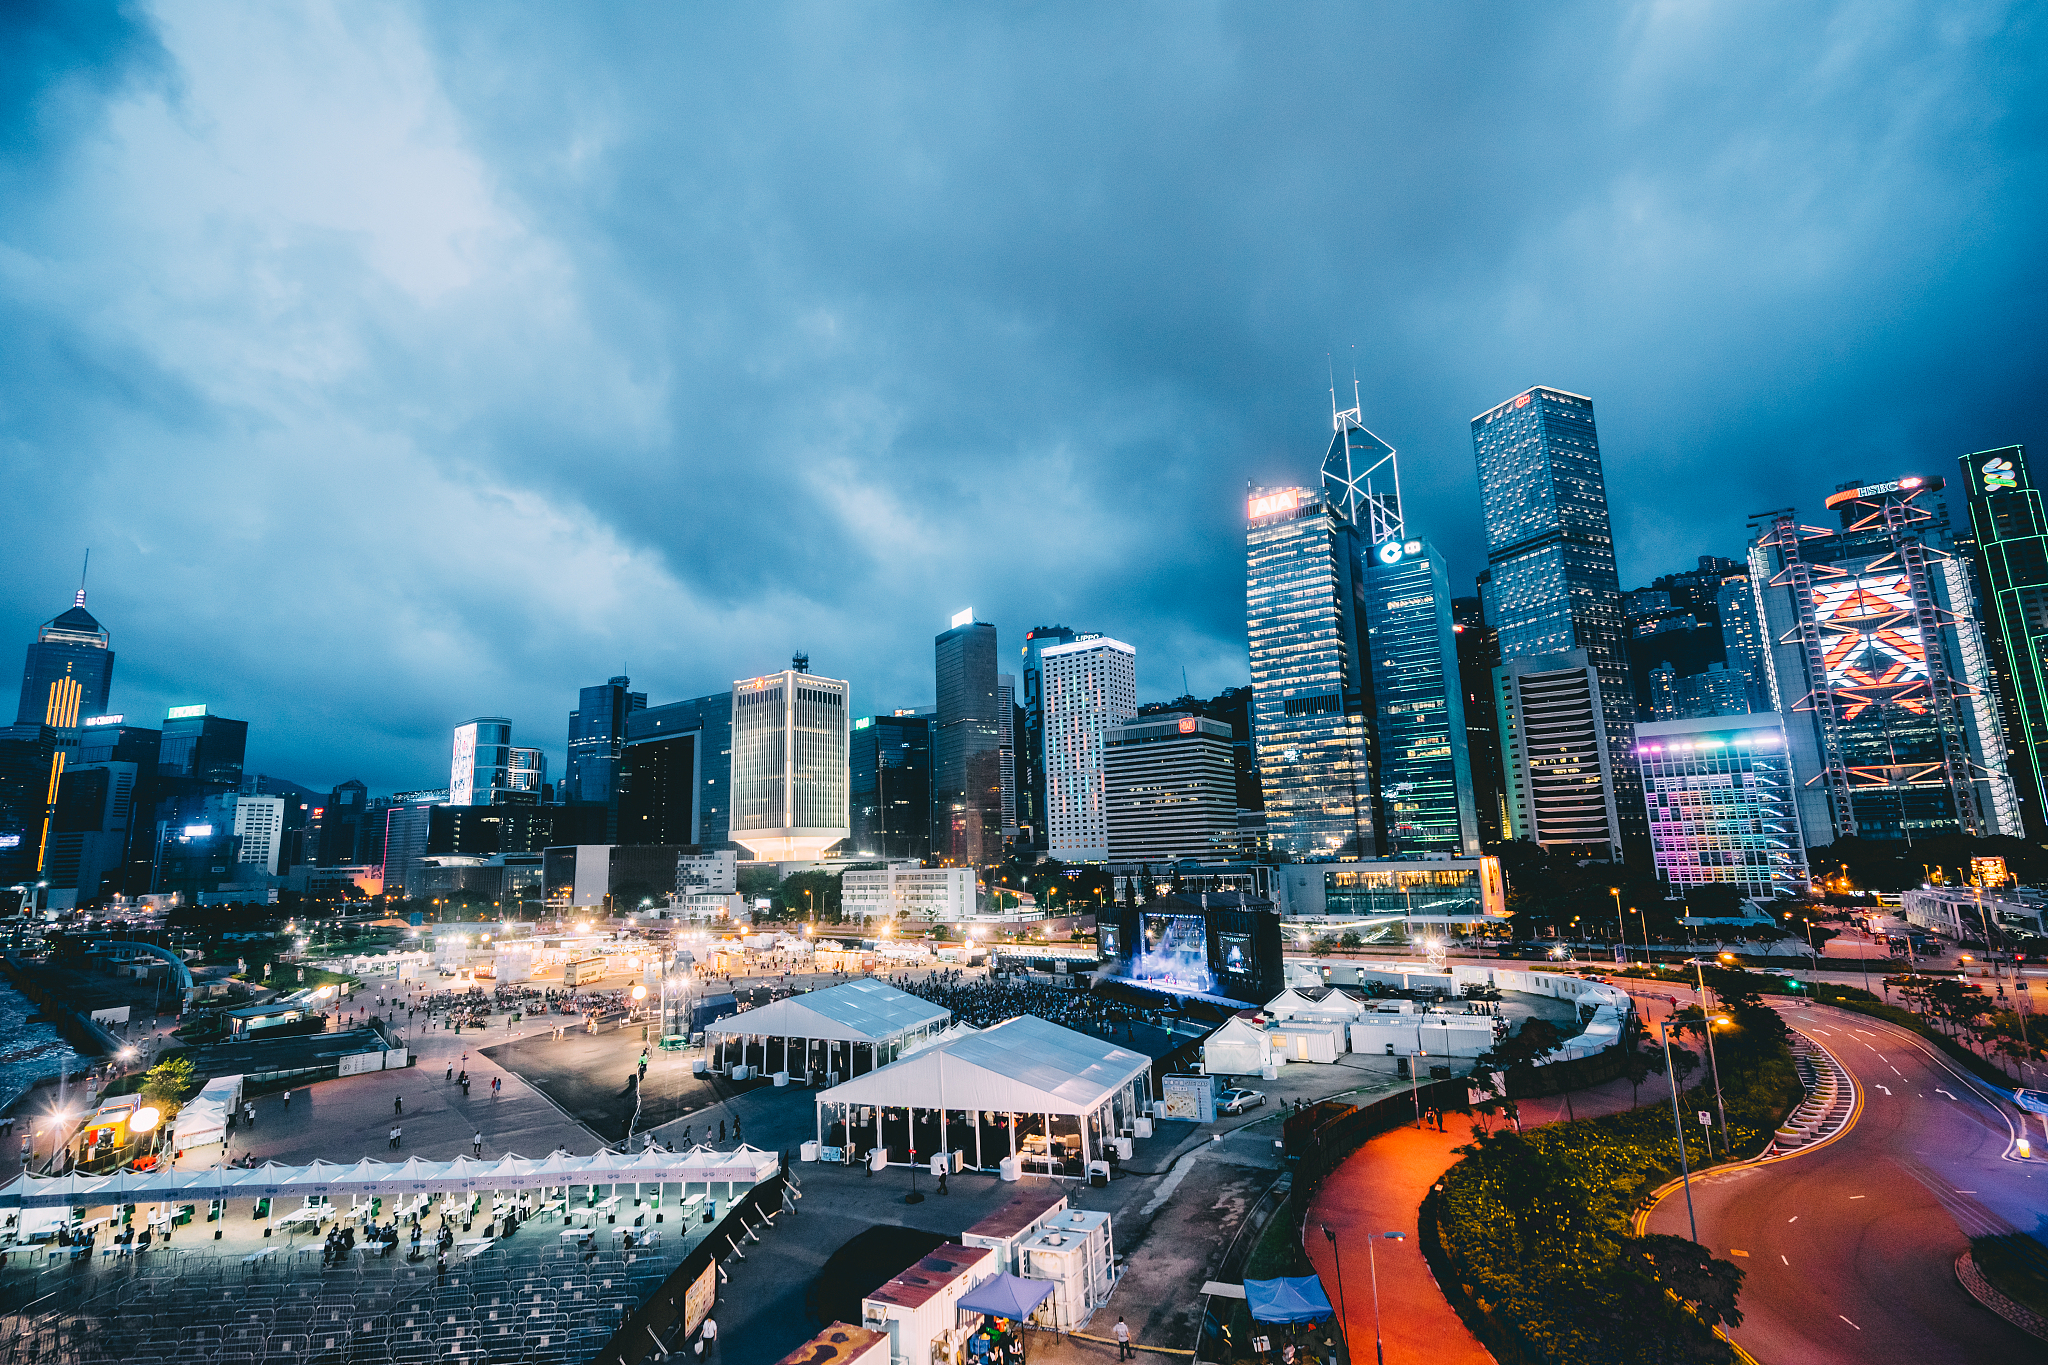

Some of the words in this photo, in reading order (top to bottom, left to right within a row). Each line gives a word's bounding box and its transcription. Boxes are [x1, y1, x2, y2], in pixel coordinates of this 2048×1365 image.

[1859, 482, 1898, 497] HSBC
[1255, 493, 1293, 515] AIA
[1075, 634, 1100, 642] LIPPO
